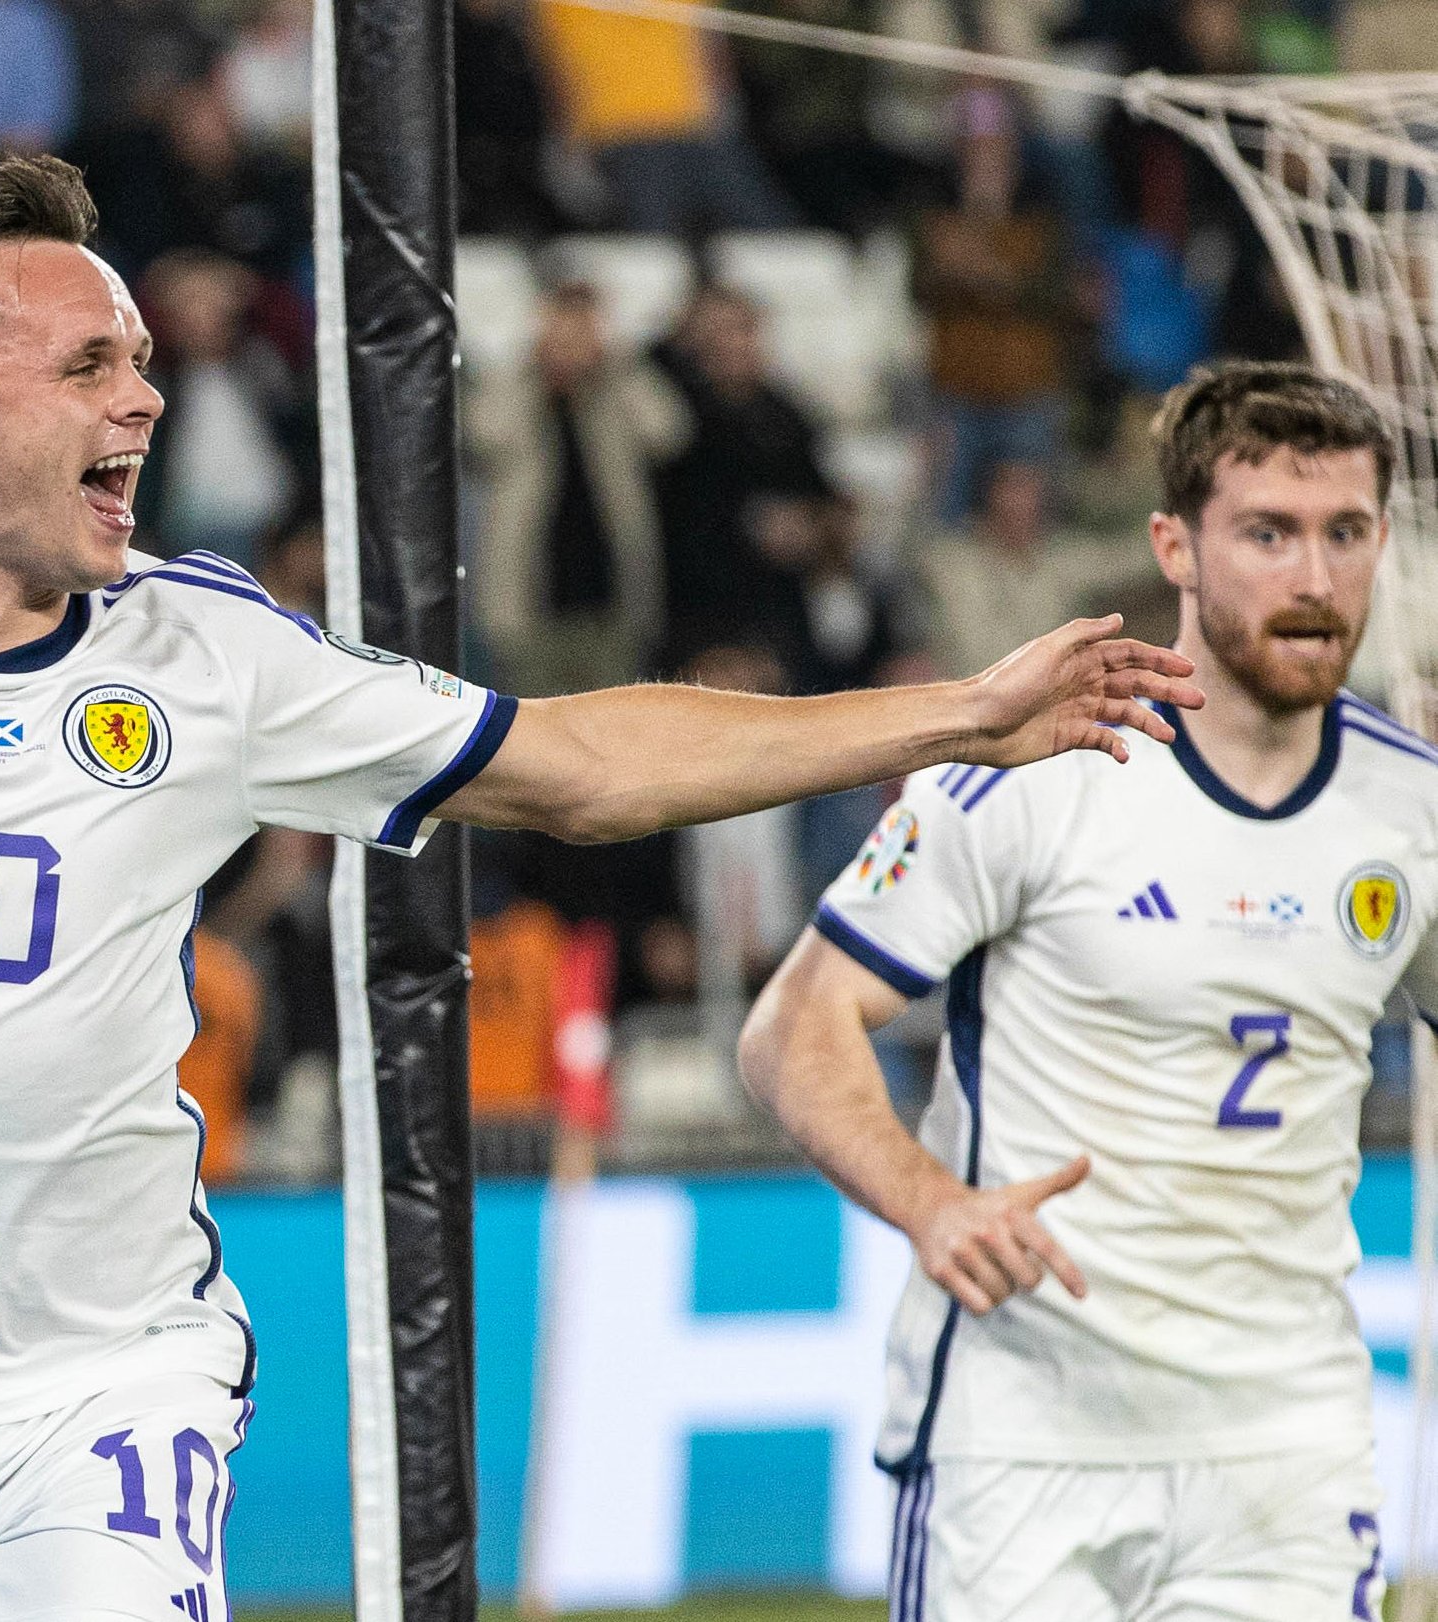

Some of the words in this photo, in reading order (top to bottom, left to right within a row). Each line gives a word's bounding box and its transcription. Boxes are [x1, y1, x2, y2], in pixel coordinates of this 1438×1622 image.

[90, 690, 141, 703] SCOTLAND
[1218, 1013, 1291, 1127] 2
[89, 1426, 220, 1577] 10
